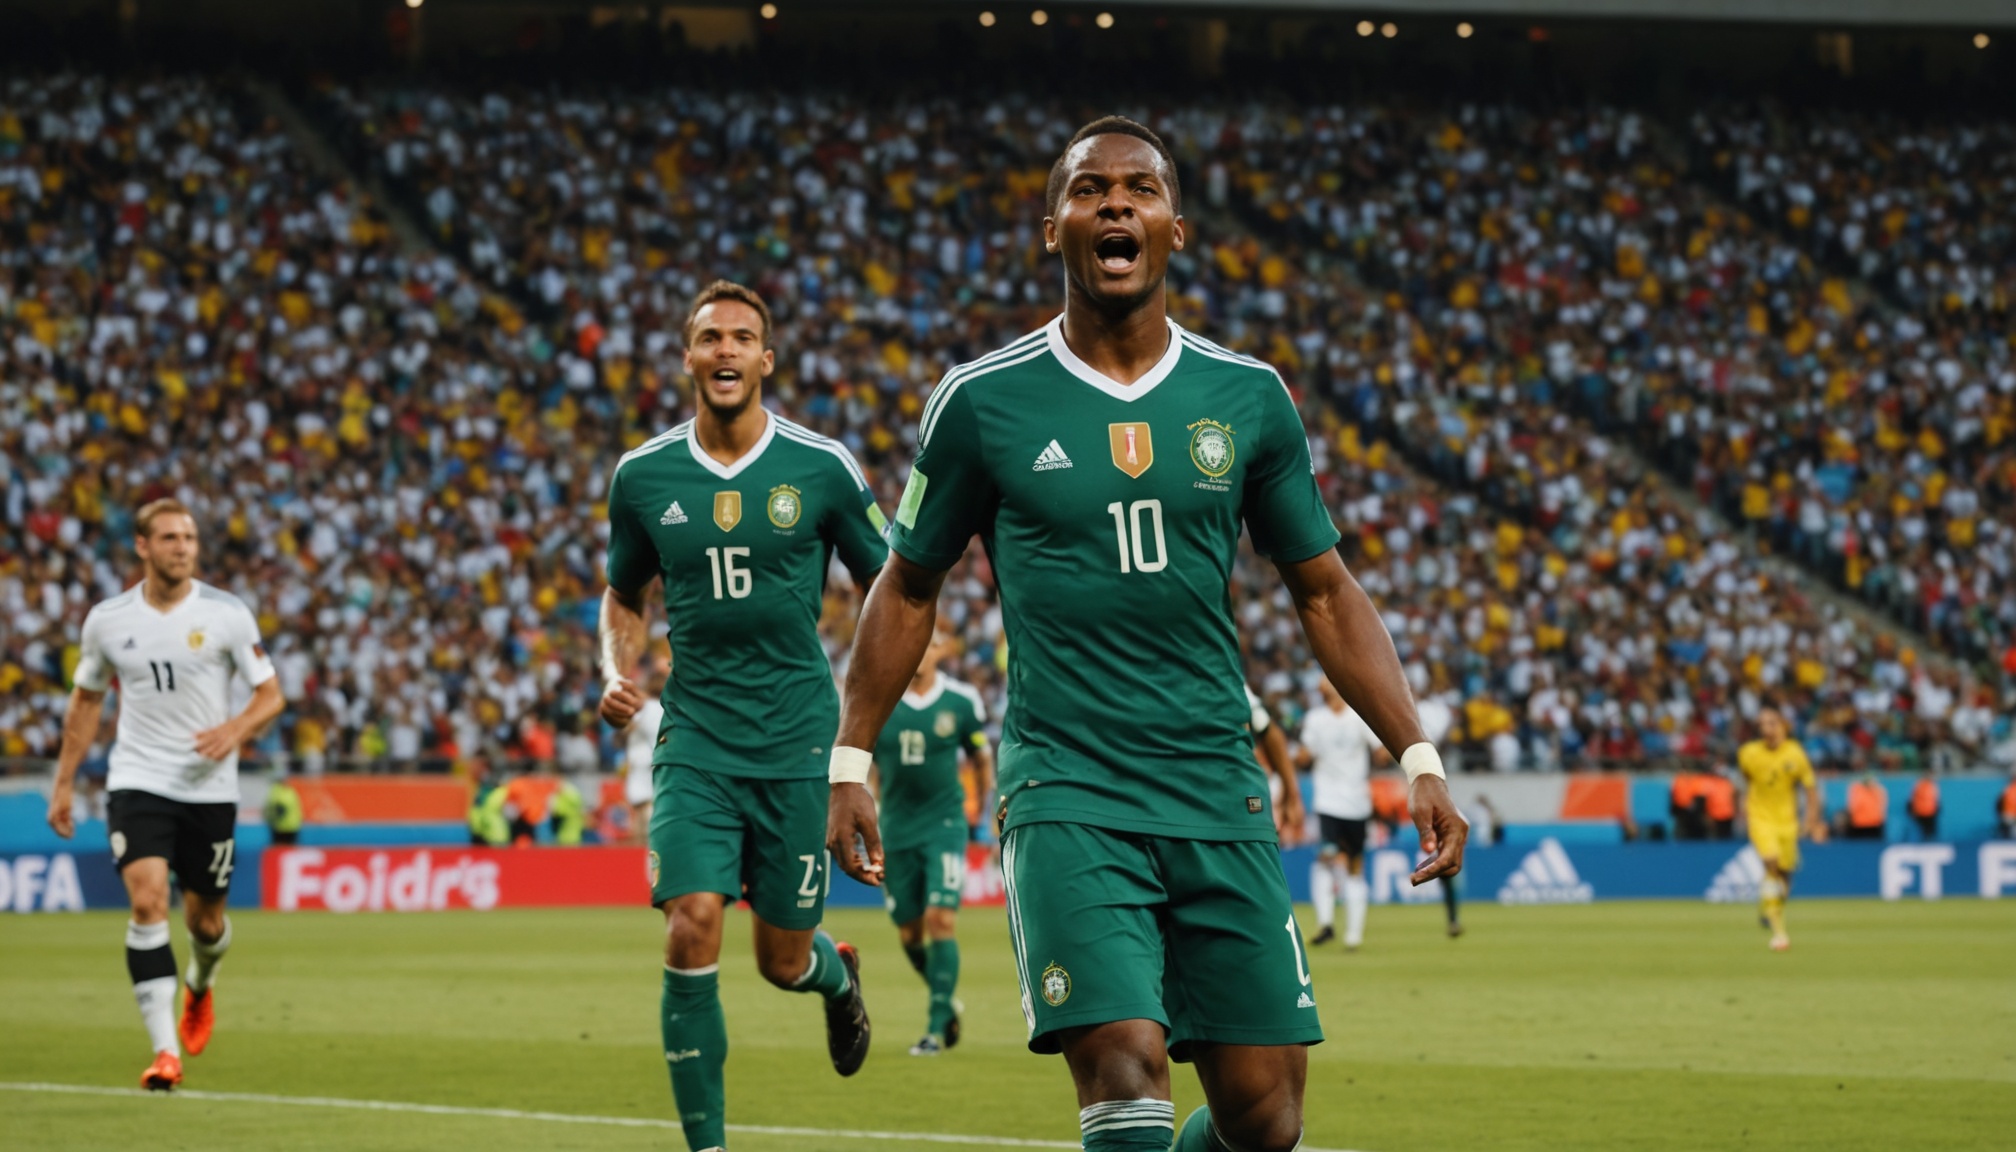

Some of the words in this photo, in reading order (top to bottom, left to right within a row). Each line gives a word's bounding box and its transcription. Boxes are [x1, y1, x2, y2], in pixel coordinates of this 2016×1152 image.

[1107, 499, 1168, 574] 10
[705, 547, 752, 600] 16
[149, 660, 175, 692] 11
[1880, 843, 1955, 902] FT
